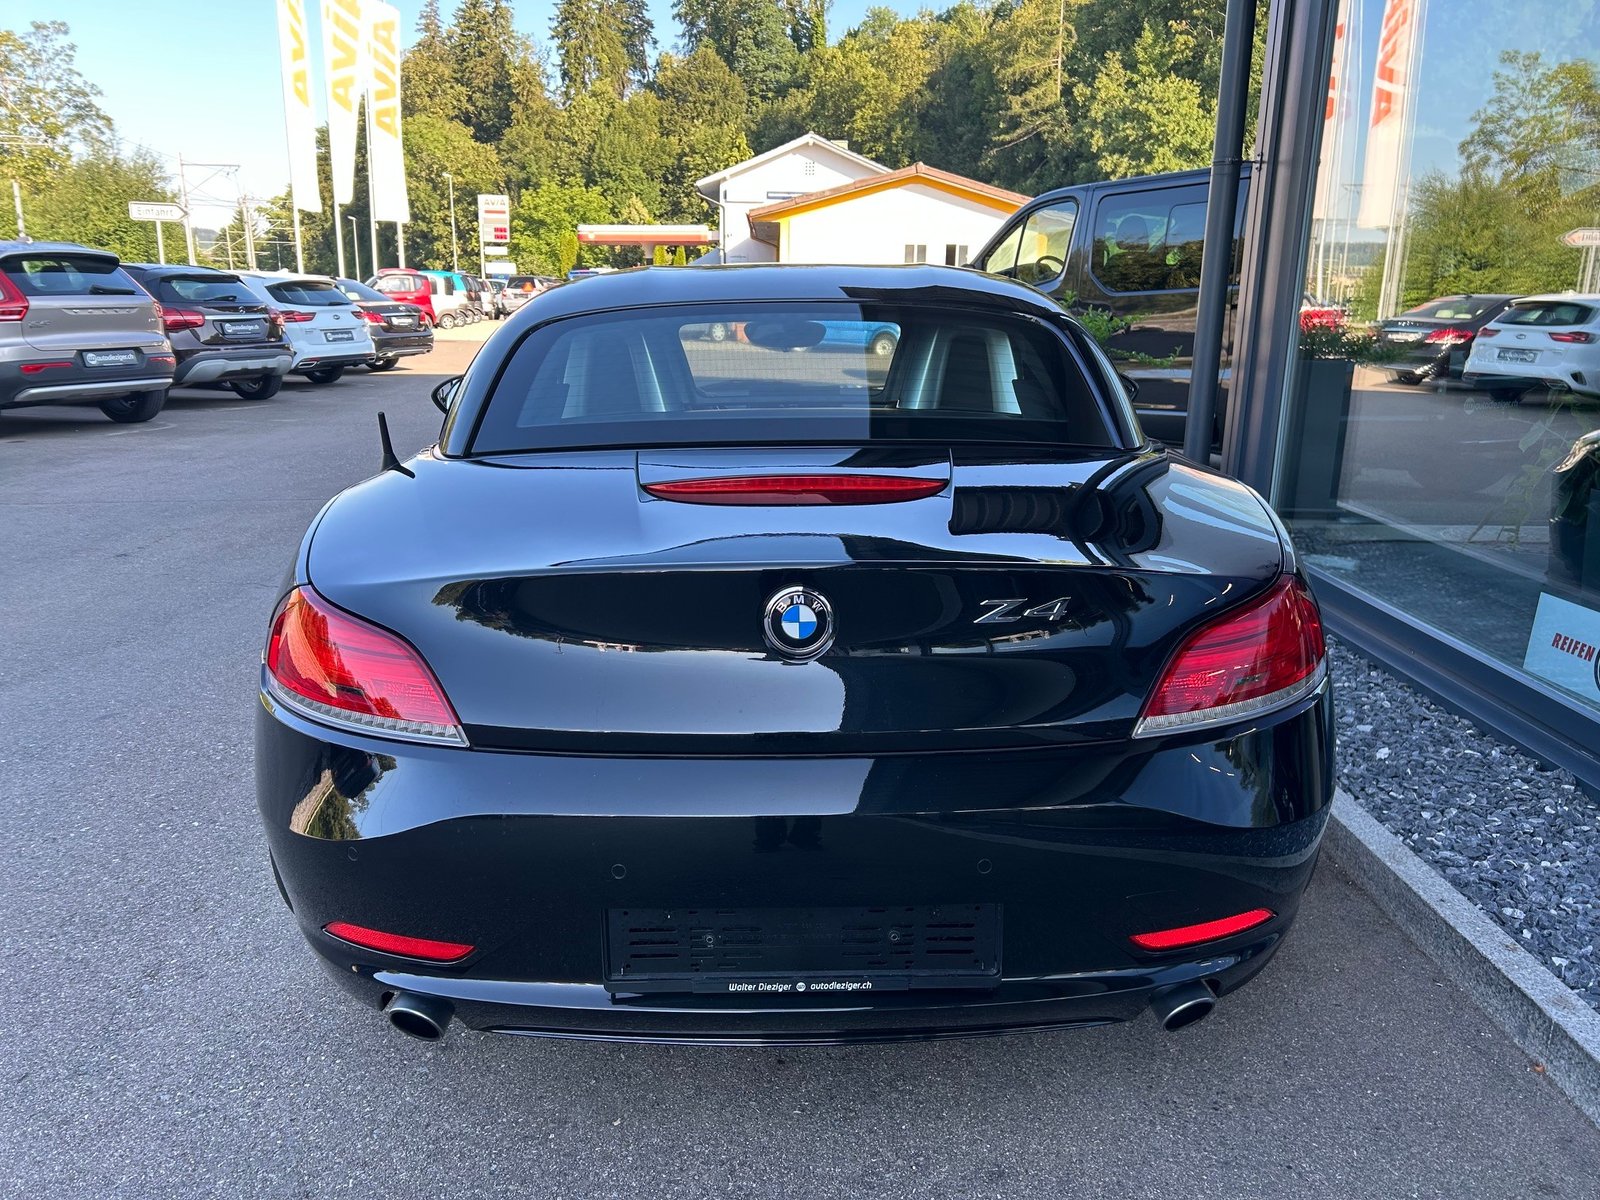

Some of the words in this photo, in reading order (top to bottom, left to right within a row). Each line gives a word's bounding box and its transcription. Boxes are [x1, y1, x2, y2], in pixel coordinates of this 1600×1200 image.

[286, 0, 309, 107] AVI
[371, 20, 399, 139] AVIA
[775, 594, 824, 614] BMW
[973, 596, 1072, 623] Z4
[1551, 632, 1596, 662] REIFEN
[728, 982, 757, 991] Walter
[758, 982, 792, 992] Dieziger
[810, 981, 872, 991] autodieziger.ch
